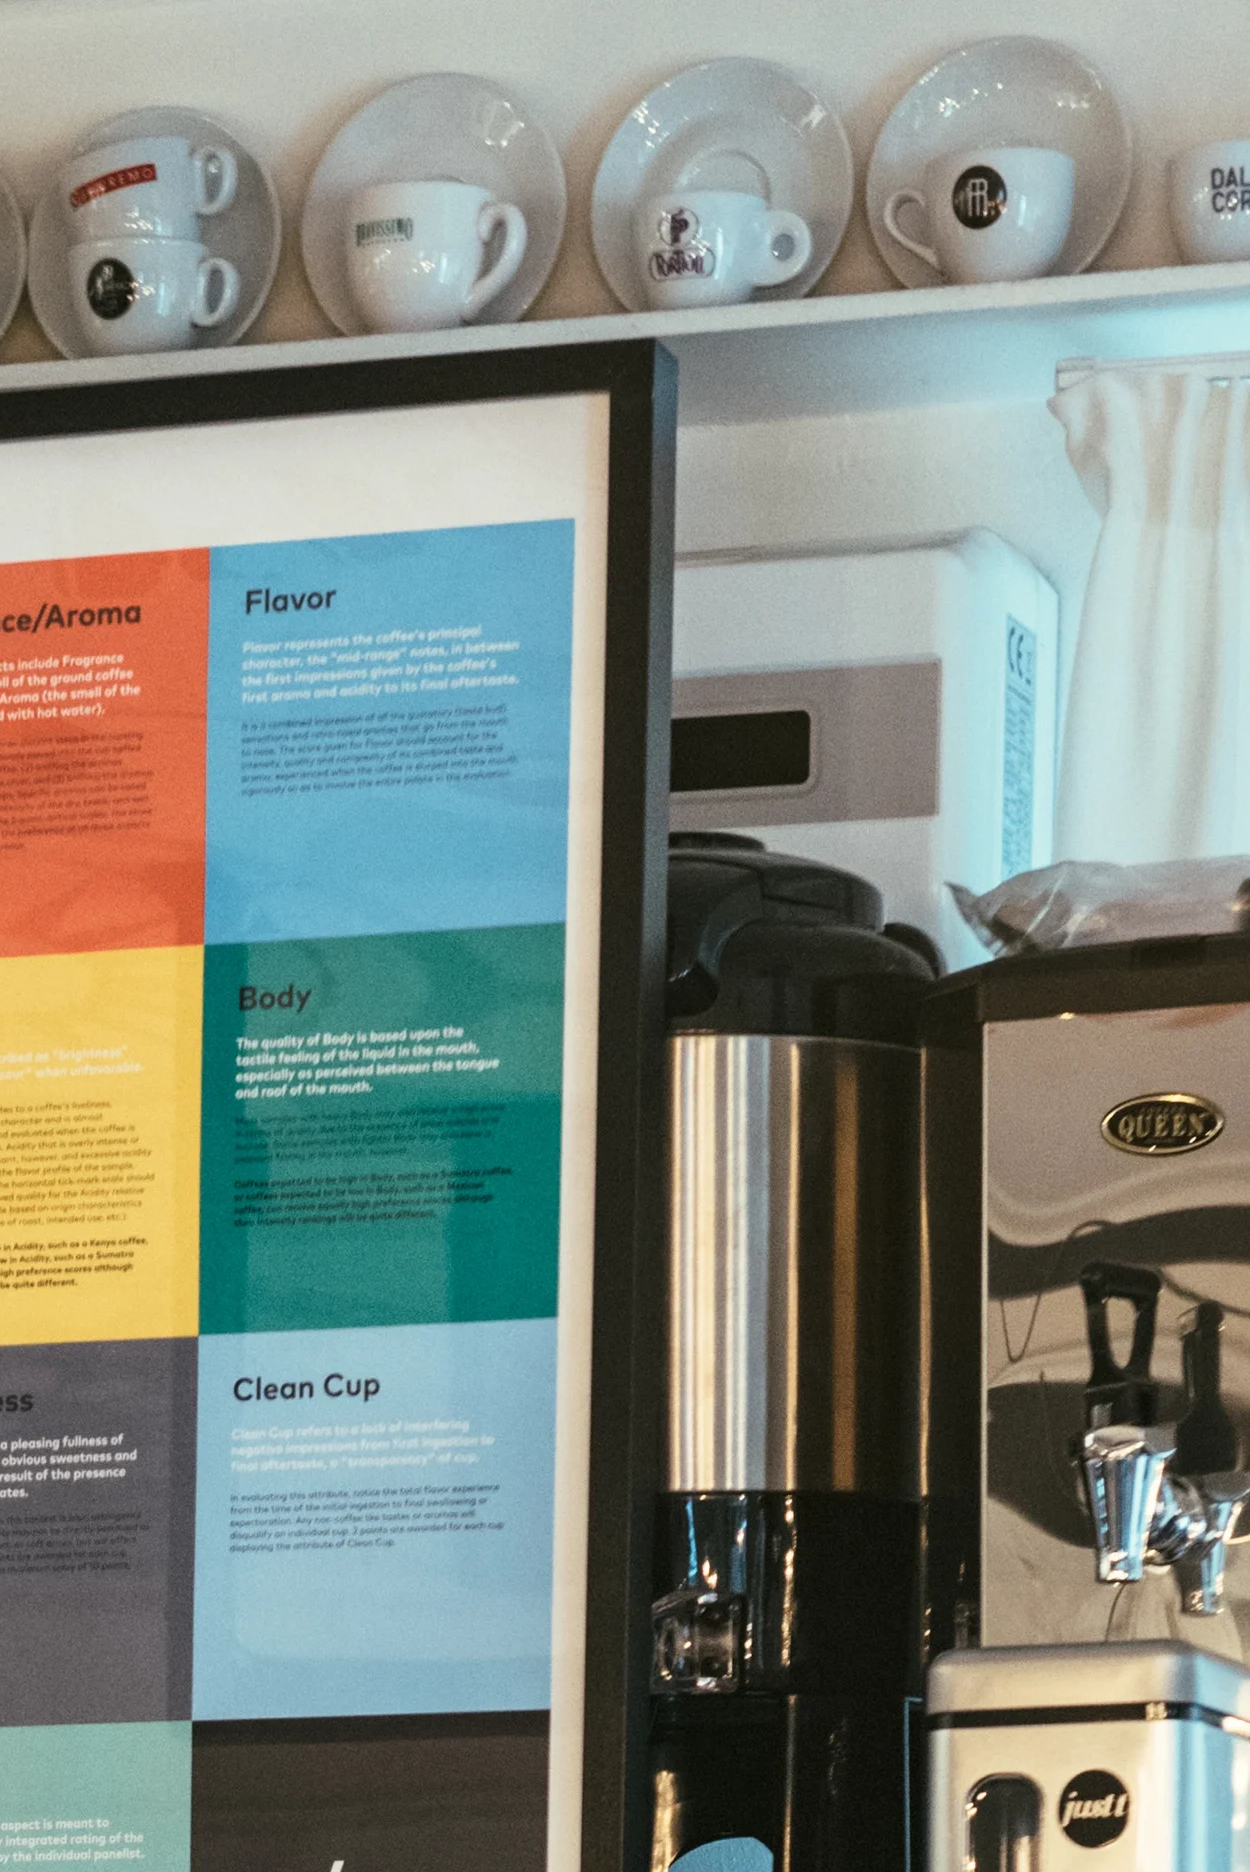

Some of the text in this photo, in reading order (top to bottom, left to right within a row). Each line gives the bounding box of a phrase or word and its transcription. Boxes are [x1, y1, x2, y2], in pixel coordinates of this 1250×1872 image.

[245, 588, 337, 615] Flavor
[239, 983, 312, 1013] Body
[237, 1027, 464, 1051] The quality of Body is based upon the
[1118, 1112, 1211, 1142] QUEEN
[233, 1373, 381, 1403] Clean Cup
[0, 1442, 8, 1451] a
[10, 1438, 60, 1454] pleasing
[62, 1436, 108, 1448] fullness
[110, 1435, 122, 1446] of
[1, 1454, 46, 1466] obvious
[49, 1451, 112, 1465] sweetness
[113, 1450, 137, 1462] and
[34, 1470, 48, 1481] of
[50, 1469, 71, 1480] the
[72, 1469, 126, 1483] presence
